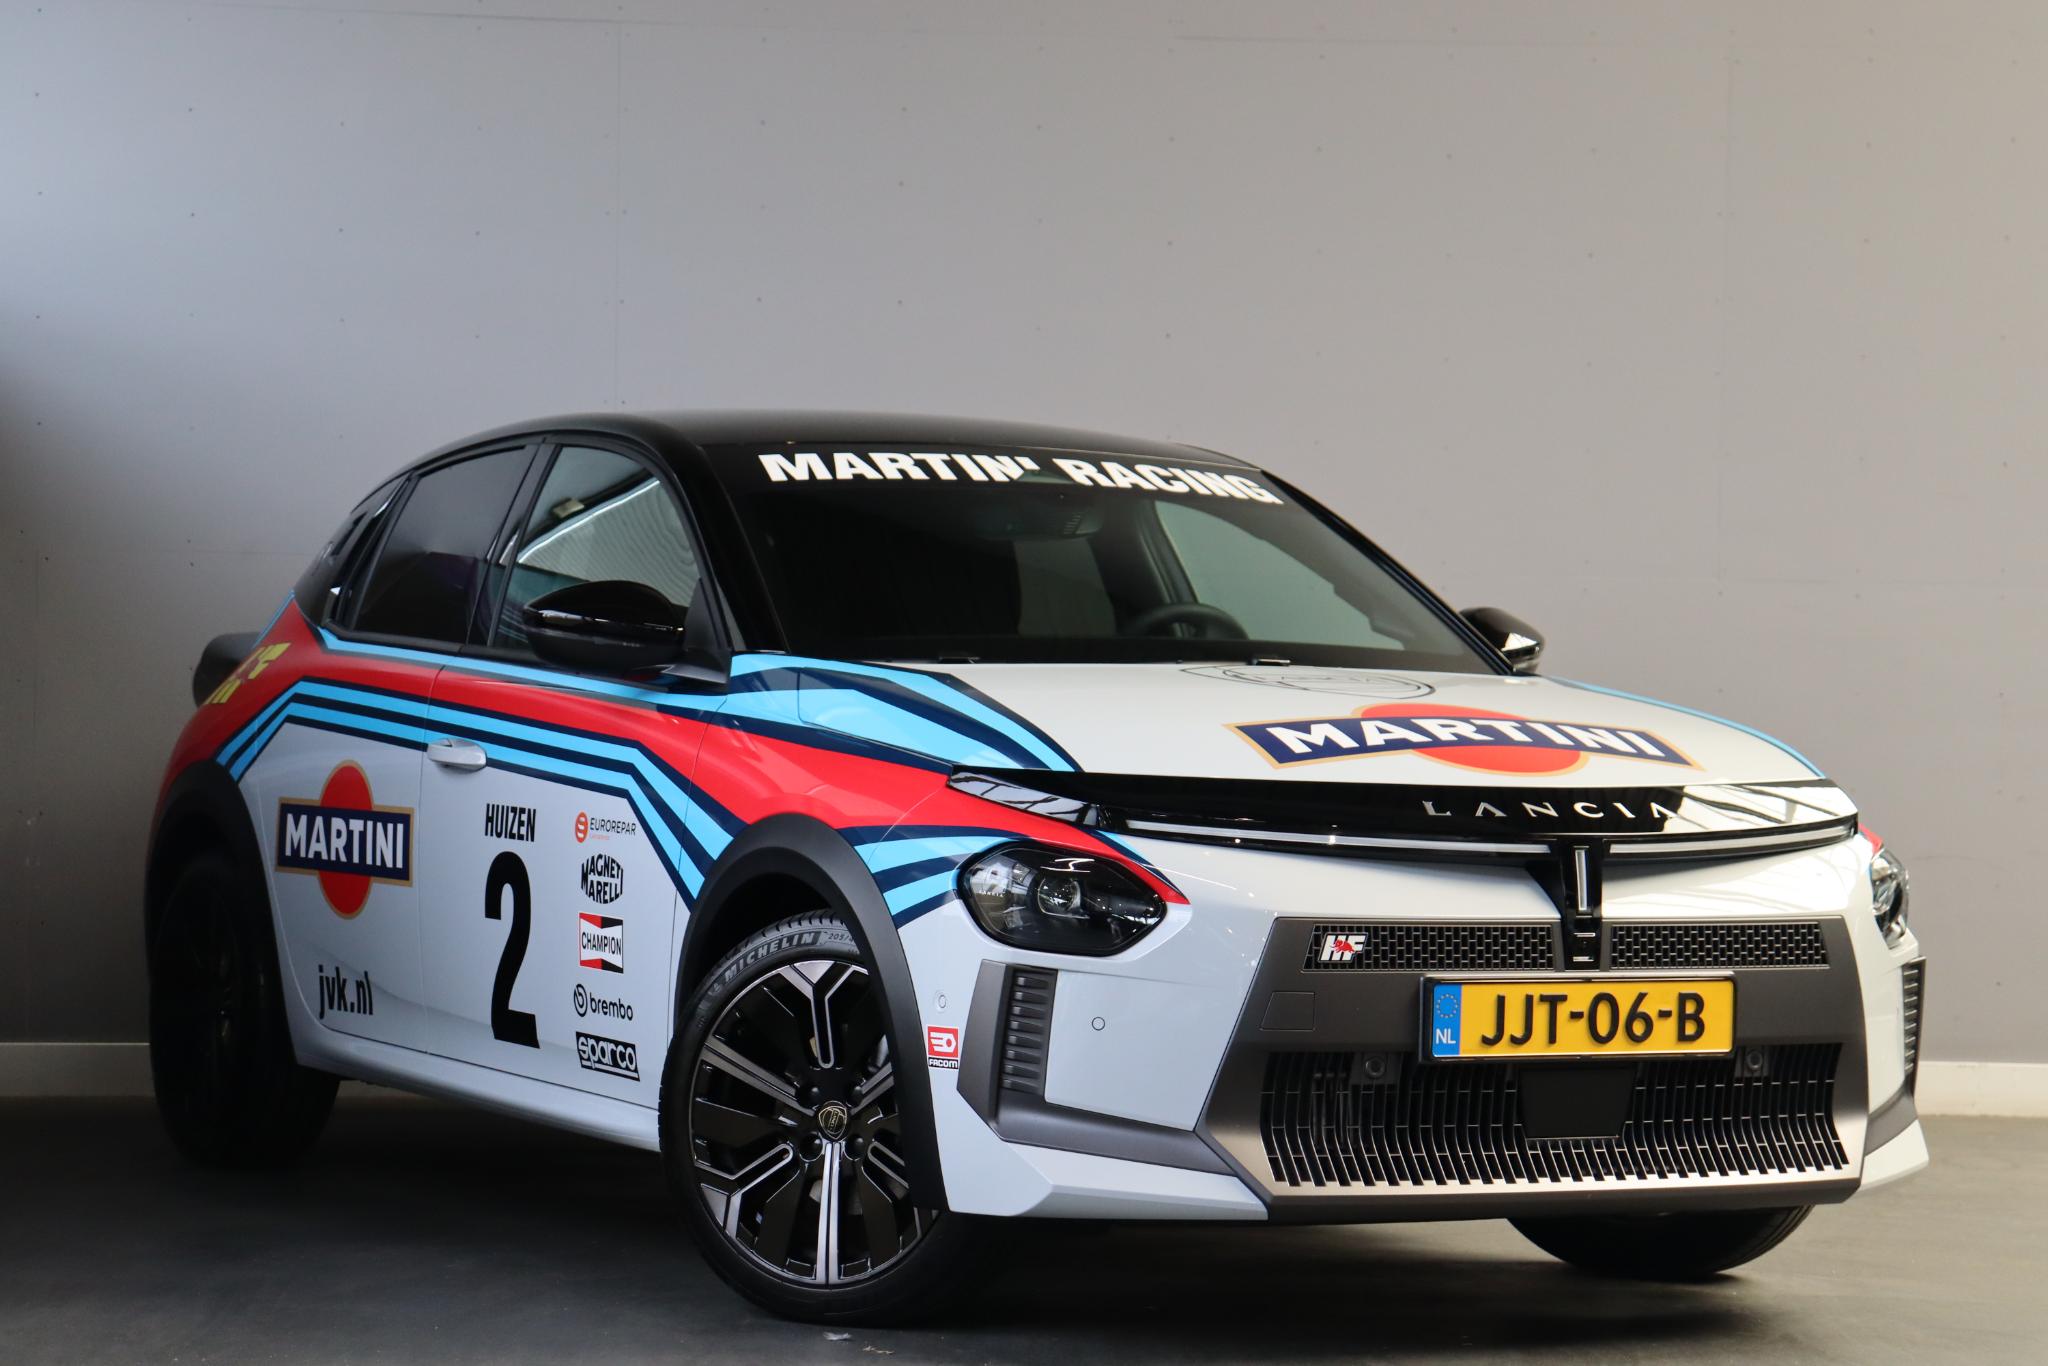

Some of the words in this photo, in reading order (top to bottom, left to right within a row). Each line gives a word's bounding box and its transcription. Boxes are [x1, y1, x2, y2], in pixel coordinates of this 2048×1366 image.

[1052, 458, 1284, 504] RACING
[1266, 718, 1665, 758] MARTINI
[485, 803, 536, 842] HUIZEN
[590, 817, 636, 836] EUROREPAR
[1422, 800, 1678, 819] LANCIA
[285, 812, 404, 869] MARTINI
[581, 853, 624, 885] MAGNETI
[581, 872, 623, 904] MARELLI
[485, 851, 540, 1049] 2
[581, 931, 622, 955] CHAMPION
[724, 931, 816, 982] MICHELIN
[318, 964, 374, 1020] jvk.nl
[590, 991, 633, 1021] brembo
[1435, 1028, 1457, 1045] NL
[1481, 992, 1706, 1046] JJT-06-B
[577, 1037, 637, 1071] sparco
